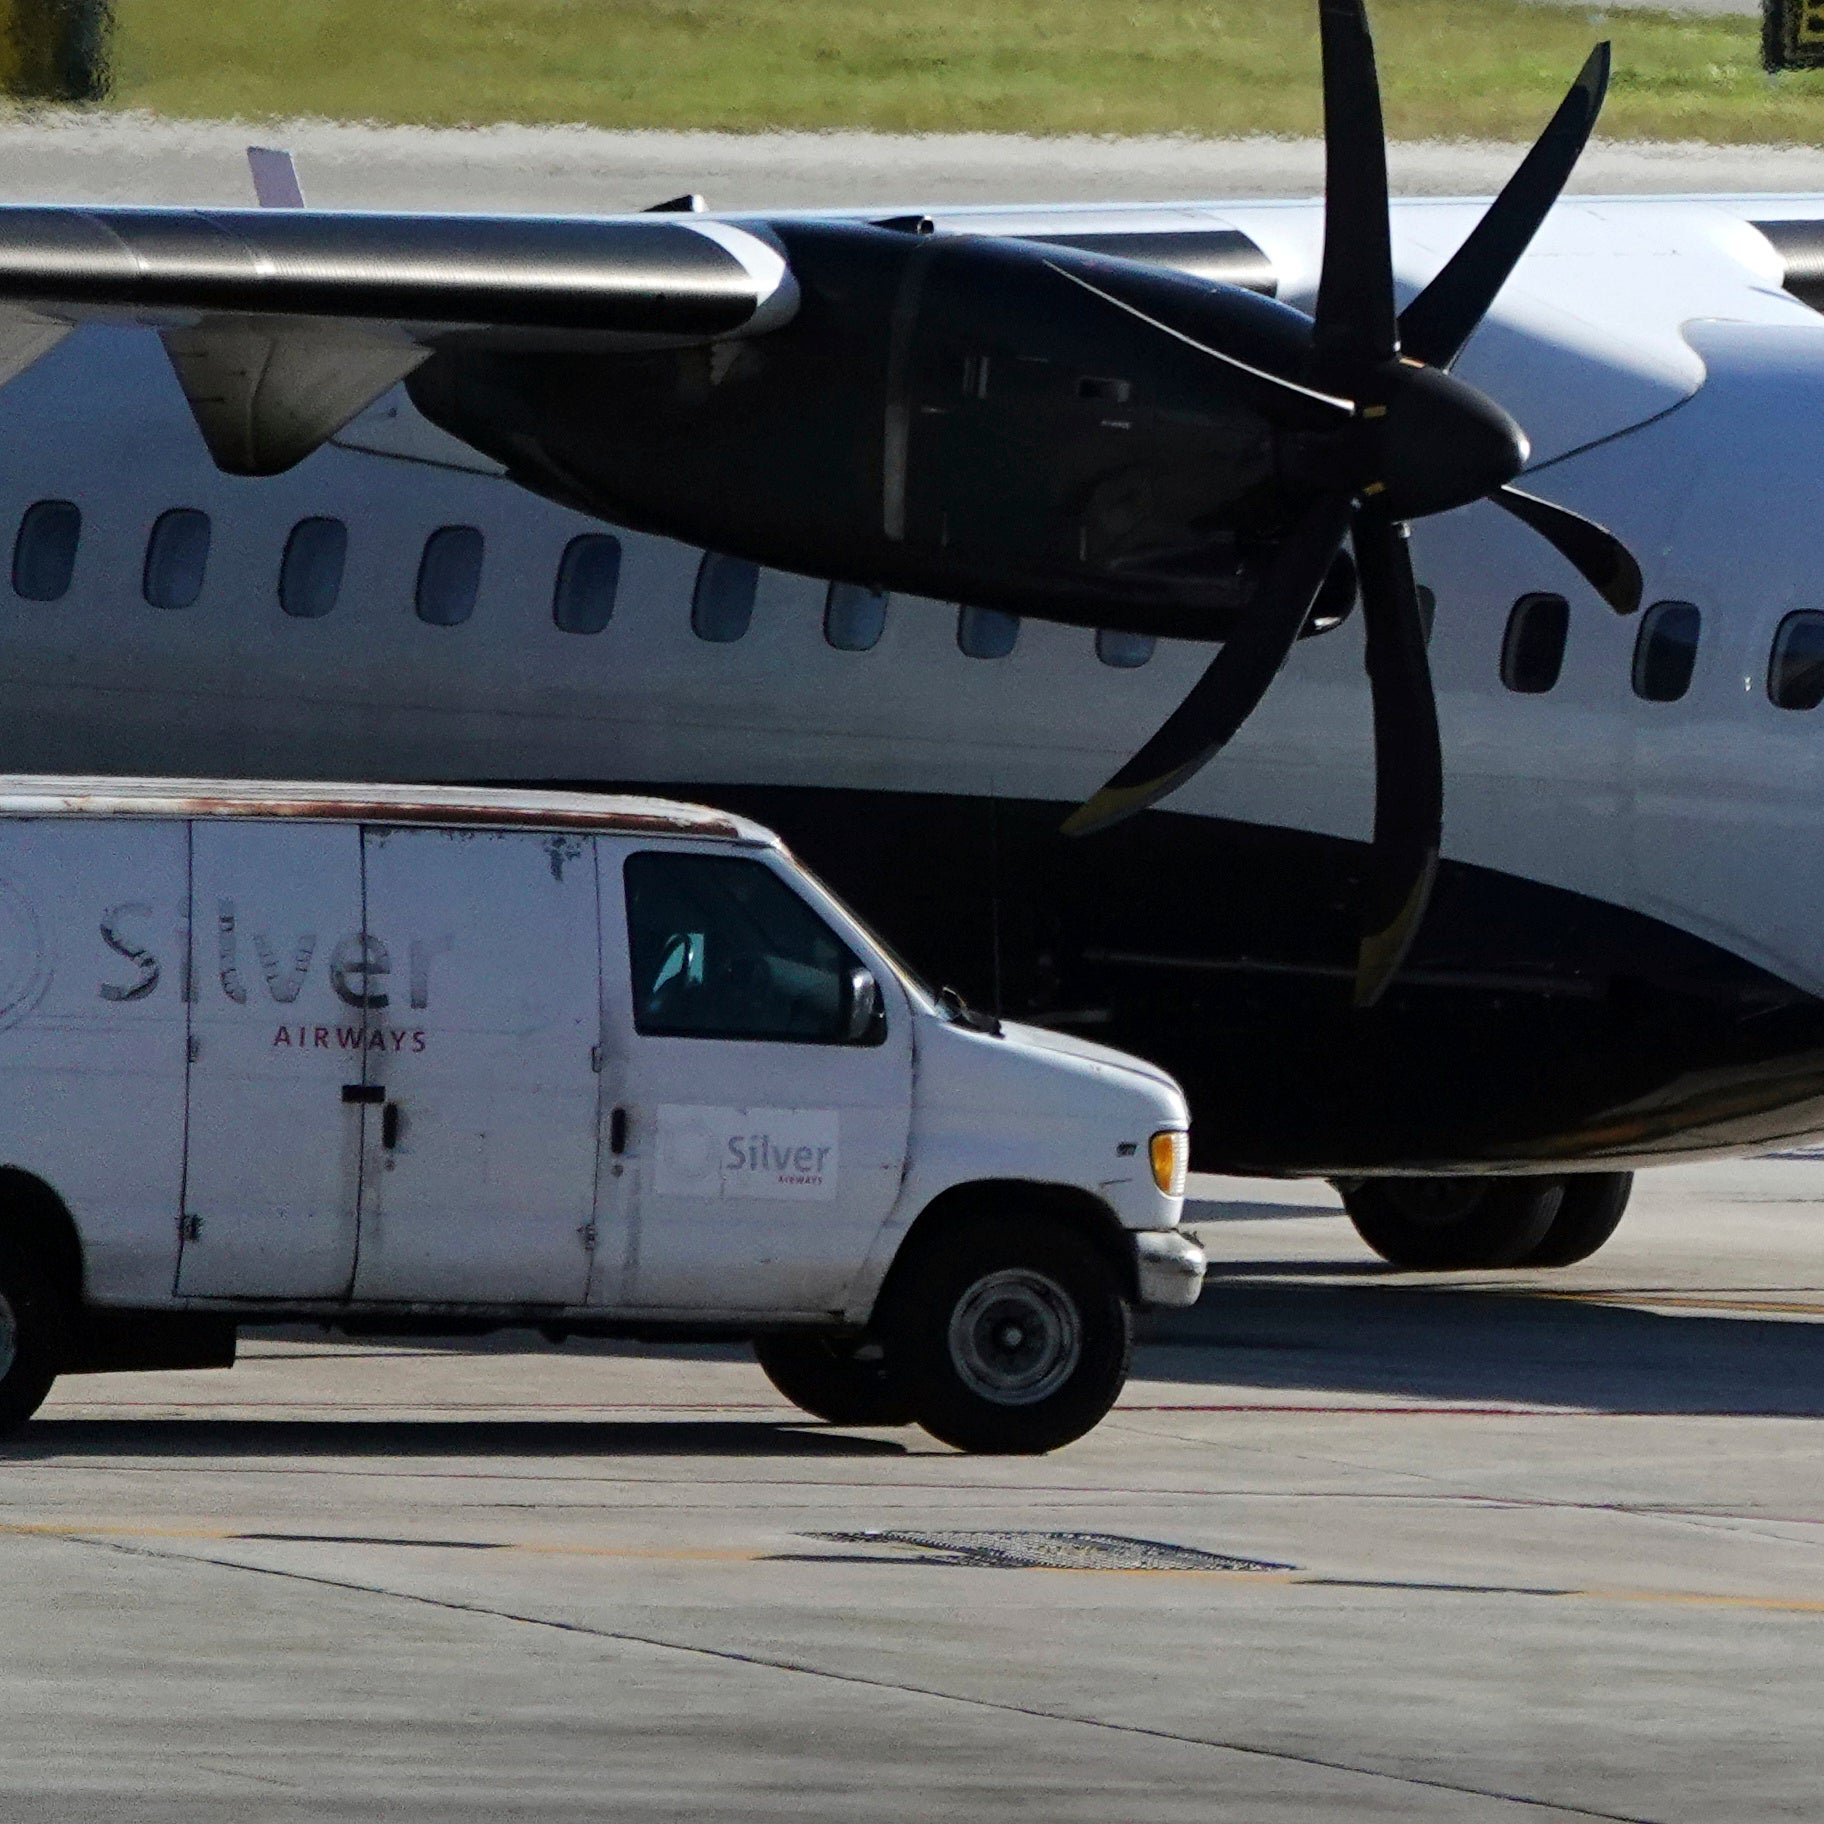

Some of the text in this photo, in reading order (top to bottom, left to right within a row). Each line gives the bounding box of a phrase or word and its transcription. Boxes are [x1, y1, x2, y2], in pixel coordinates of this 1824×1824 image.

[99, 897, 453, 1010] Silver
[273, 1025, 428, 1053] AIRWAYS
[726, 1132, 833, 1174] Silver
[777, 1174, 824, 1186] AIRWAYS
